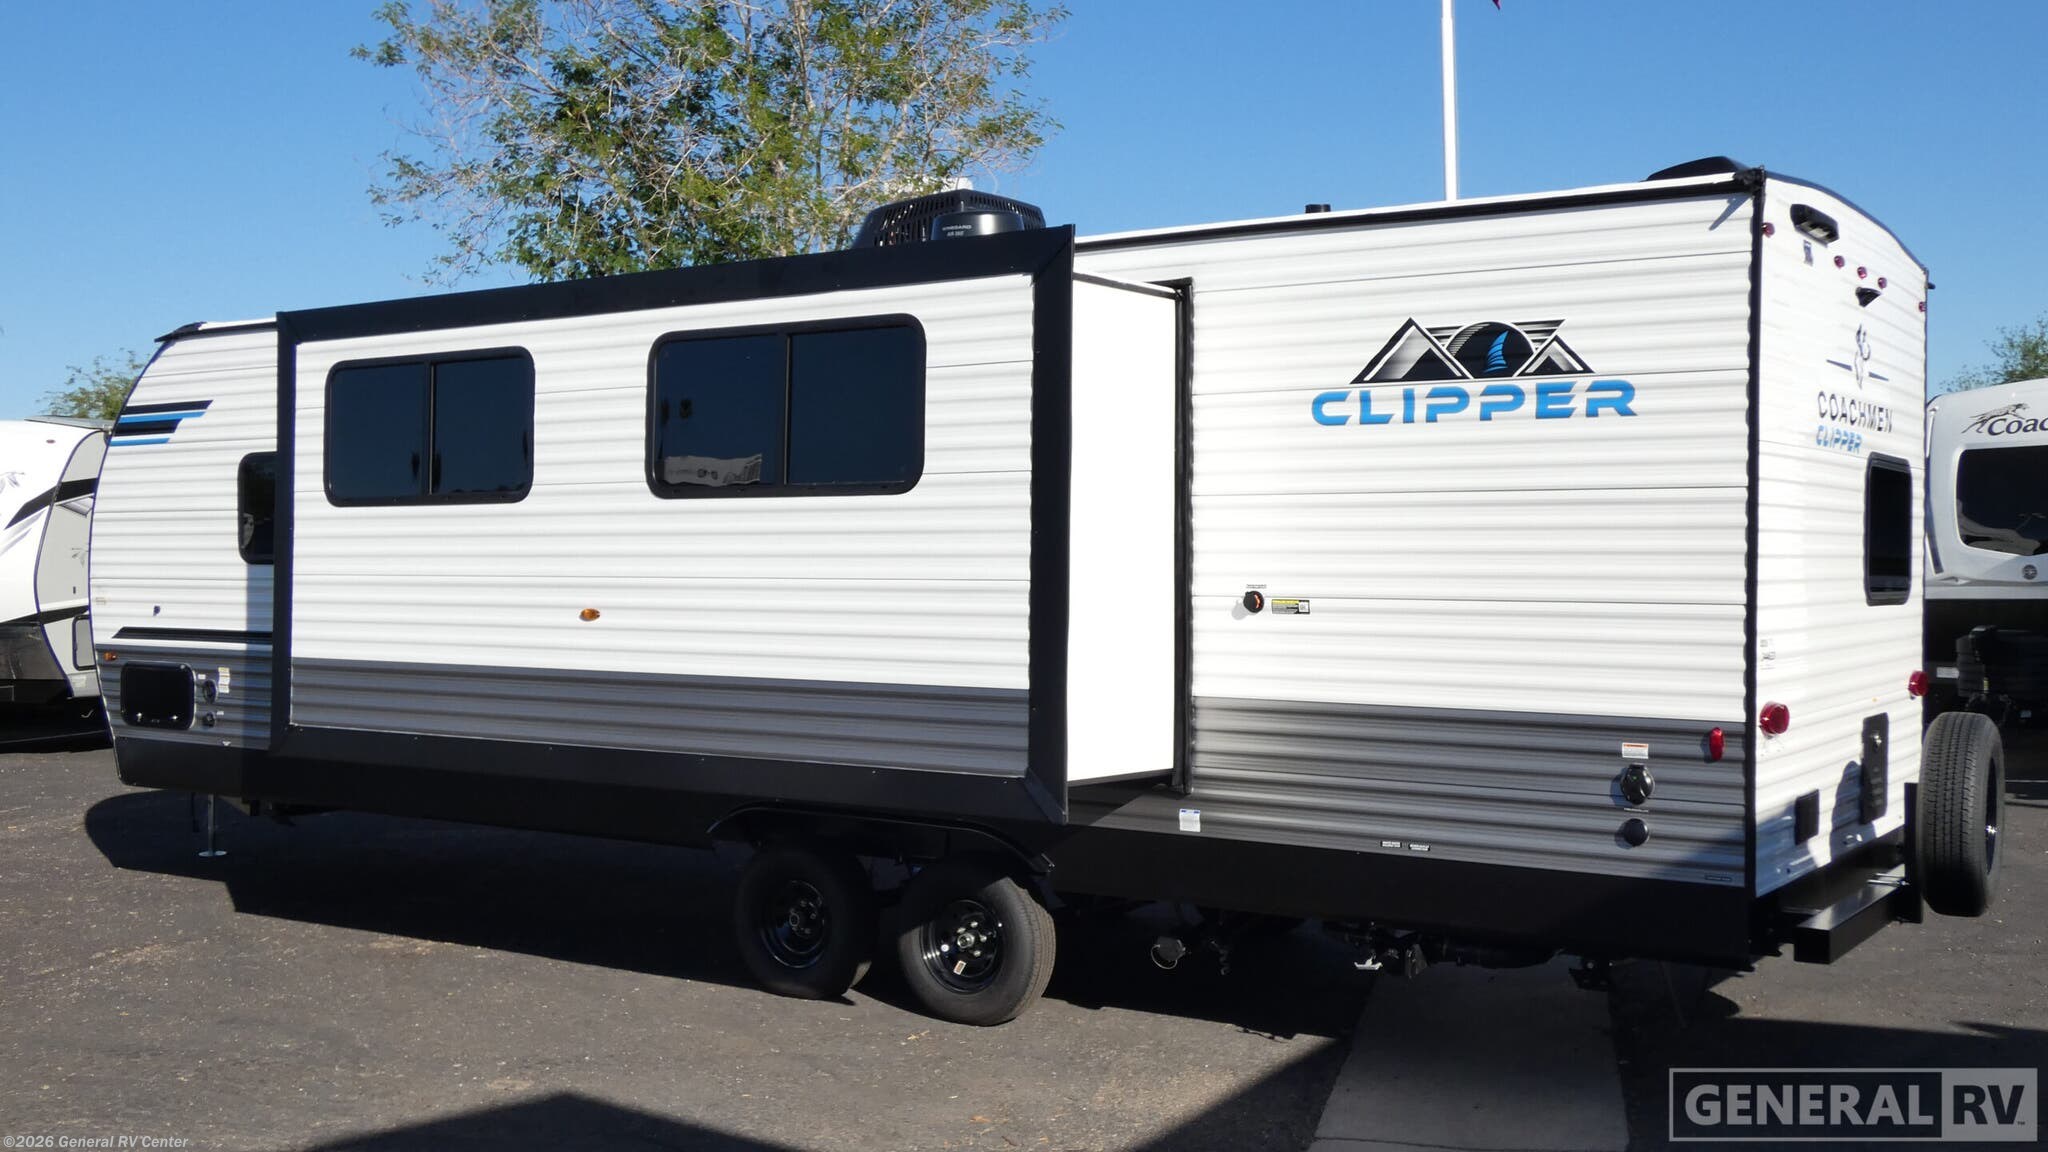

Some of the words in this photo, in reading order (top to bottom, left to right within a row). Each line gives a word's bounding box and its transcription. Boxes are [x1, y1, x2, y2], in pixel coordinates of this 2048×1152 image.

[1312, 379, 1637, 426] CLIPPER
[1817, 390, 1894, 433] COACHMEN
[1815, 424, 1863, 454] CLIPPER
[1987, 416, 2048, 436] Coac
